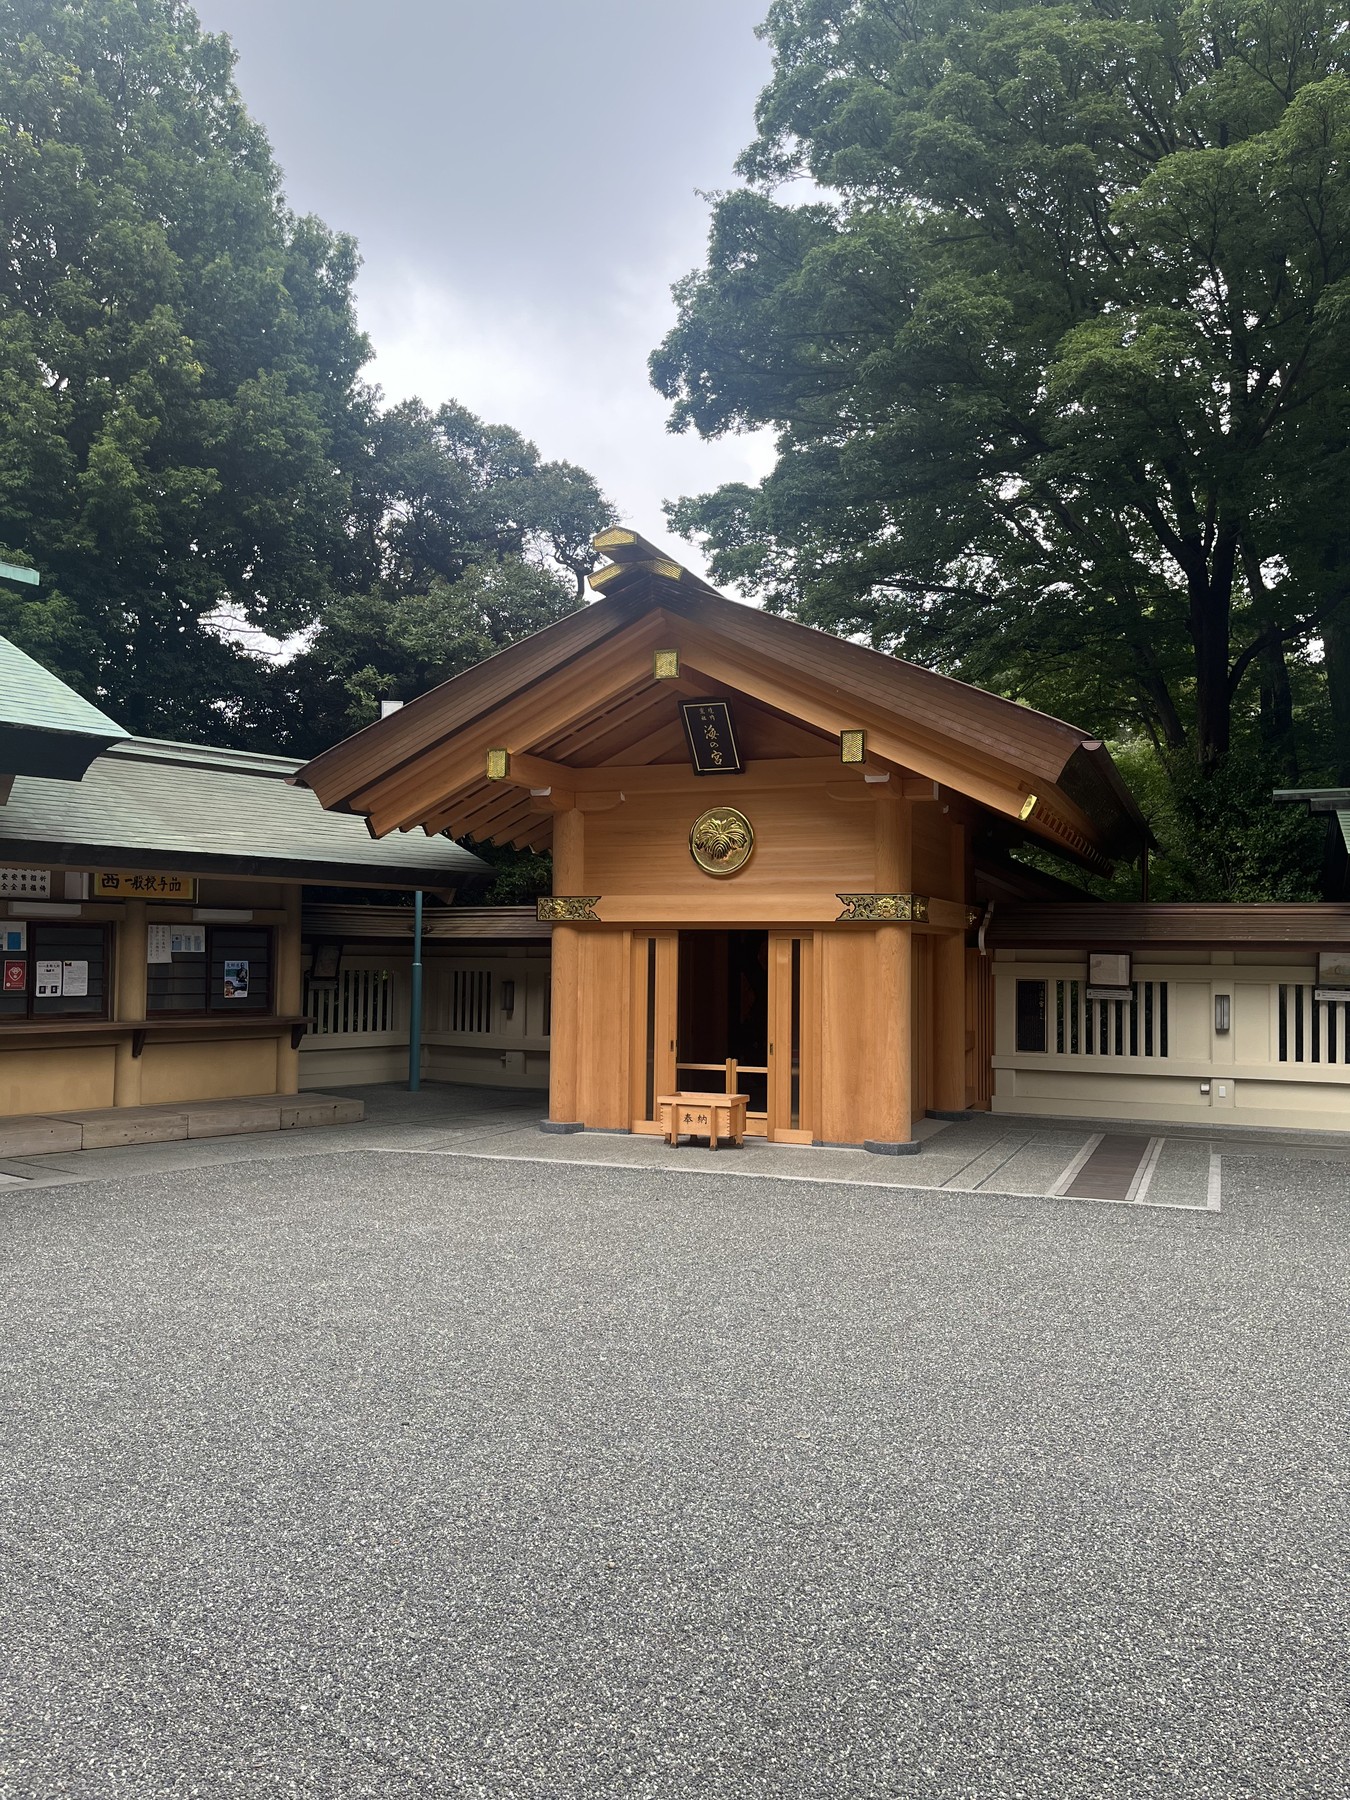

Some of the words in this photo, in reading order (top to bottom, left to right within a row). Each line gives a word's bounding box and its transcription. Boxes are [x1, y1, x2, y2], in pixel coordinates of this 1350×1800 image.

[703, 724, 723, 765] 海の宮
[10, 868, 18, 891] 安全
[39, 870, 47, 893] 祈祷
[101, 873, 120, 890] 西
[124, 874, 181, 892] 一般授与品
[683, 1113, 707, 1125] 奉納
